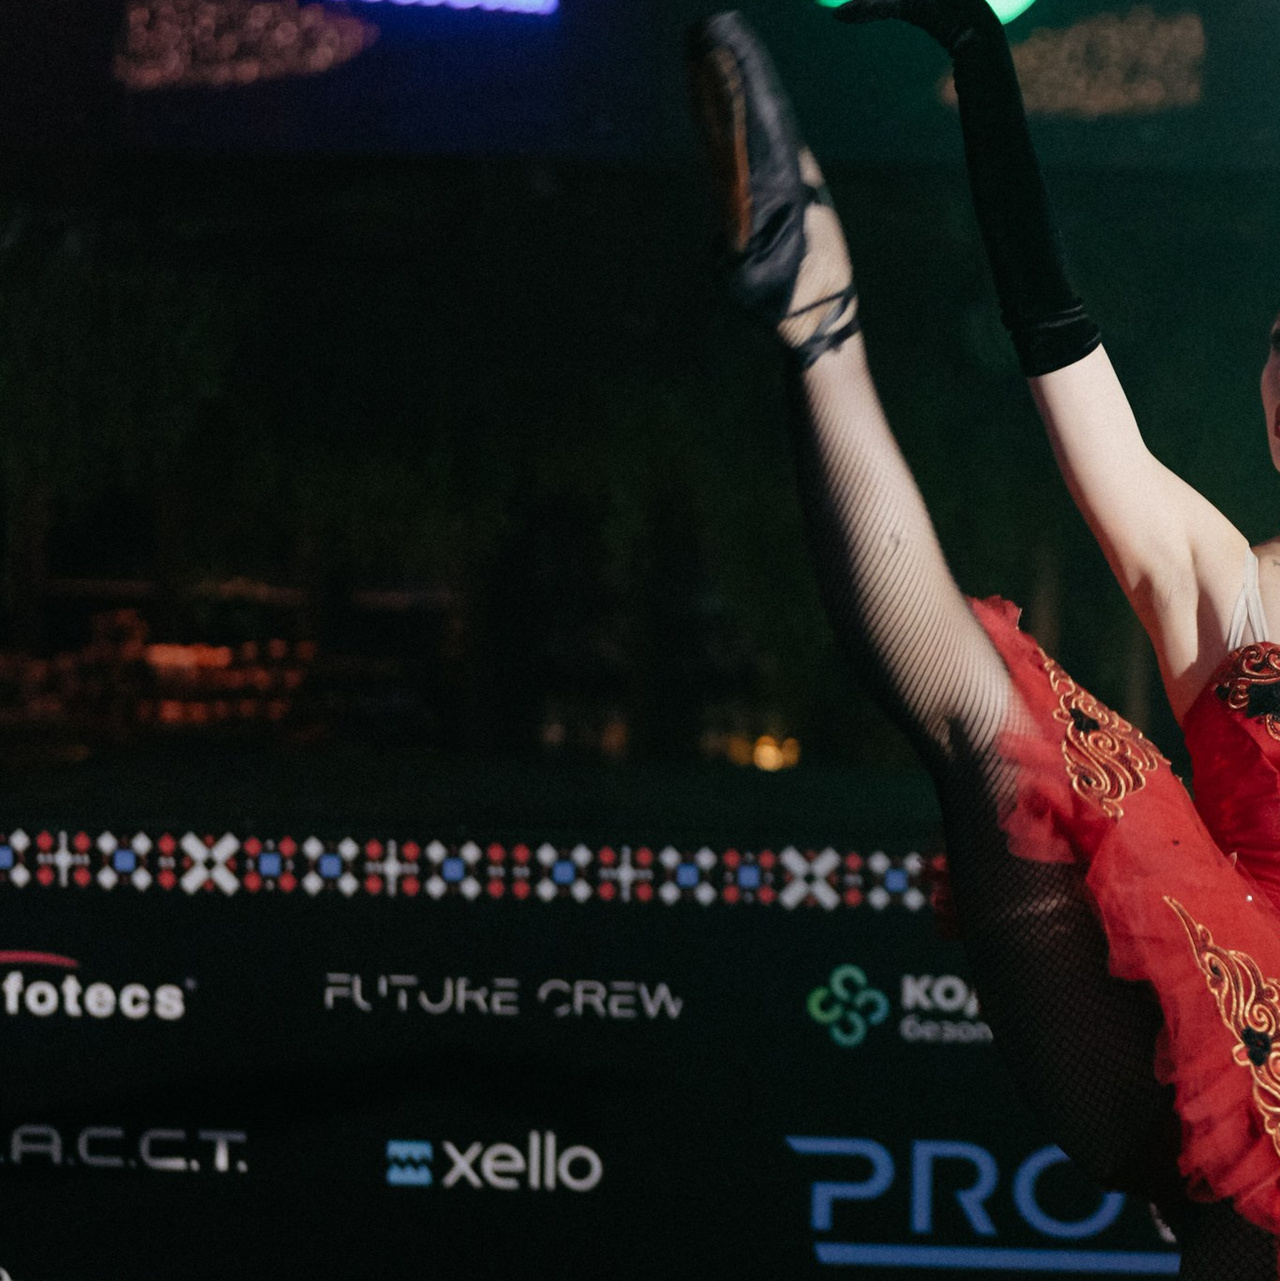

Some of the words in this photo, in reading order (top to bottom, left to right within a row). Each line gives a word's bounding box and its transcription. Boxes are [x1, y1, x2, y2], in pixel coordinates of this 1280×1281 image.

[324, 973, 520, 1016] FUTURE
[537, 979, 684, 1019] CREW
[442, 1130, 603, 1192] xello
[785, 1135, 1177, 1243] PRO
